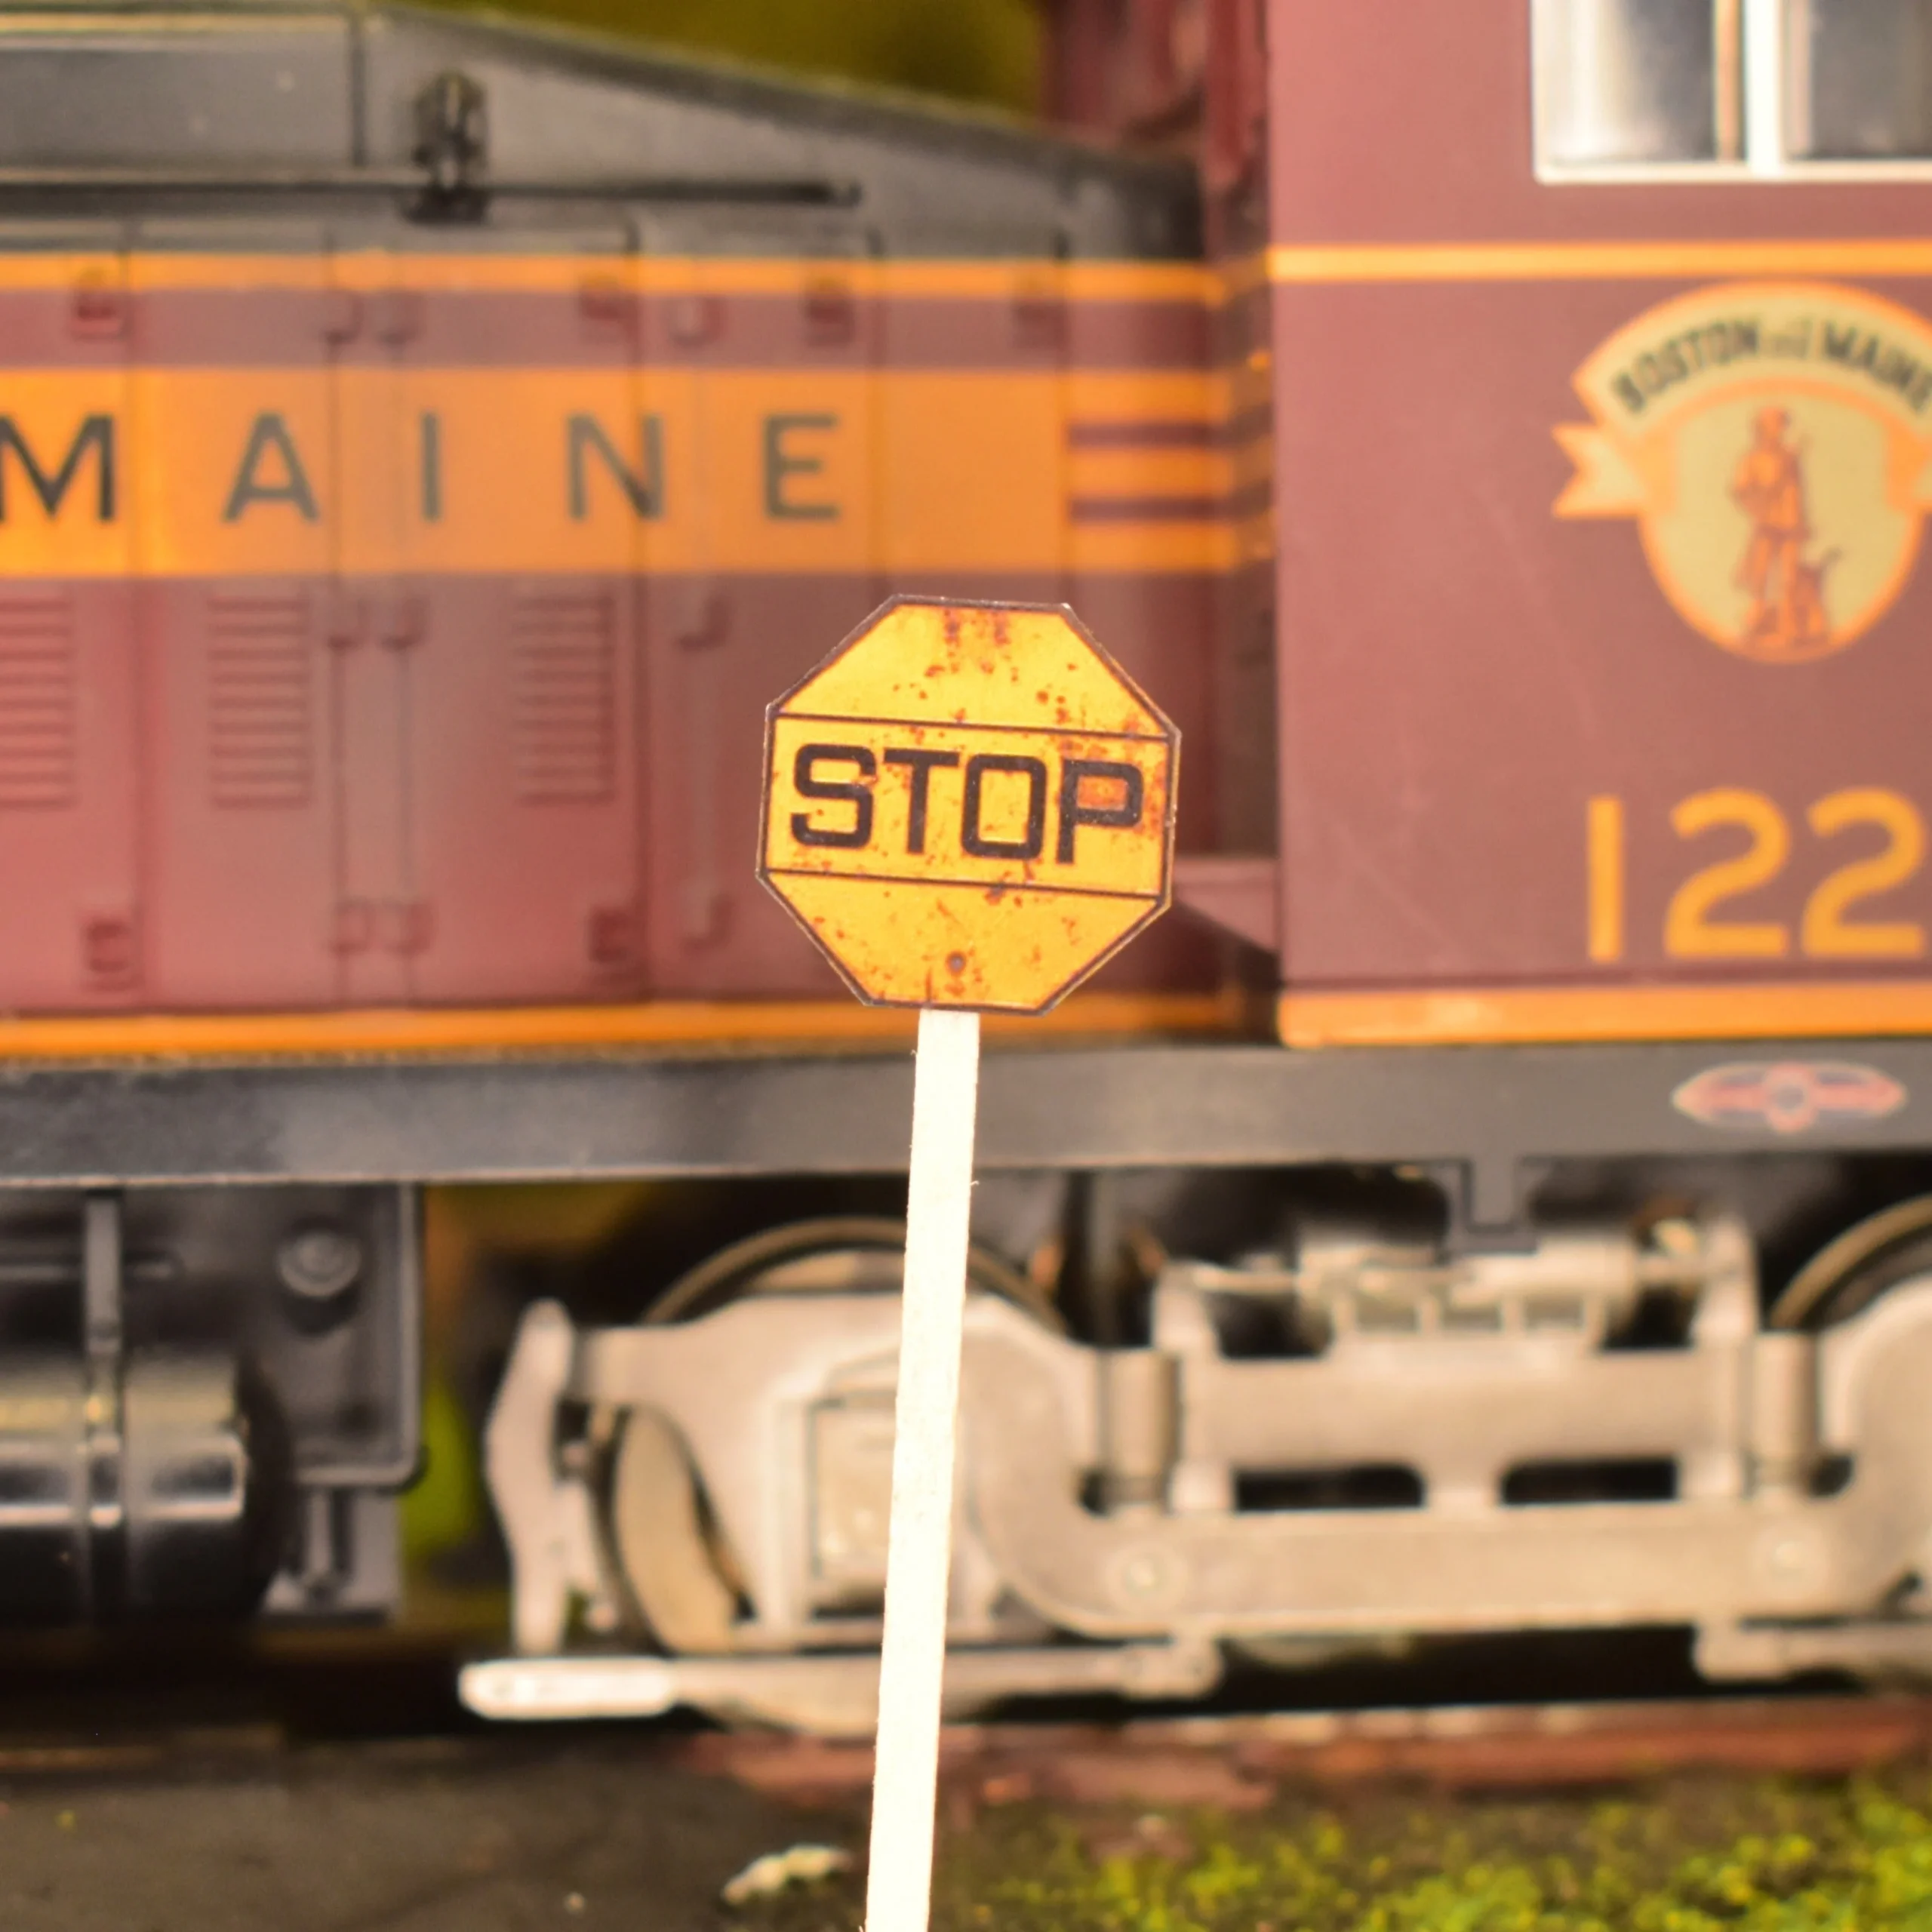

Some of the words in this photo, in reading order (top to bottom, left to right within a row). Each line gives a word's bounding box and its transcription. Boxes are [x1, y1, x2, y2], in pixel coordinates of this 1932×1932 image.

[1612, 317, 1758, 412] BOSTON
[0, 412, 841, 521] MAINE
[790, 742, 1145, 865] STOP
[1587, 786, 1927, 964] 122
